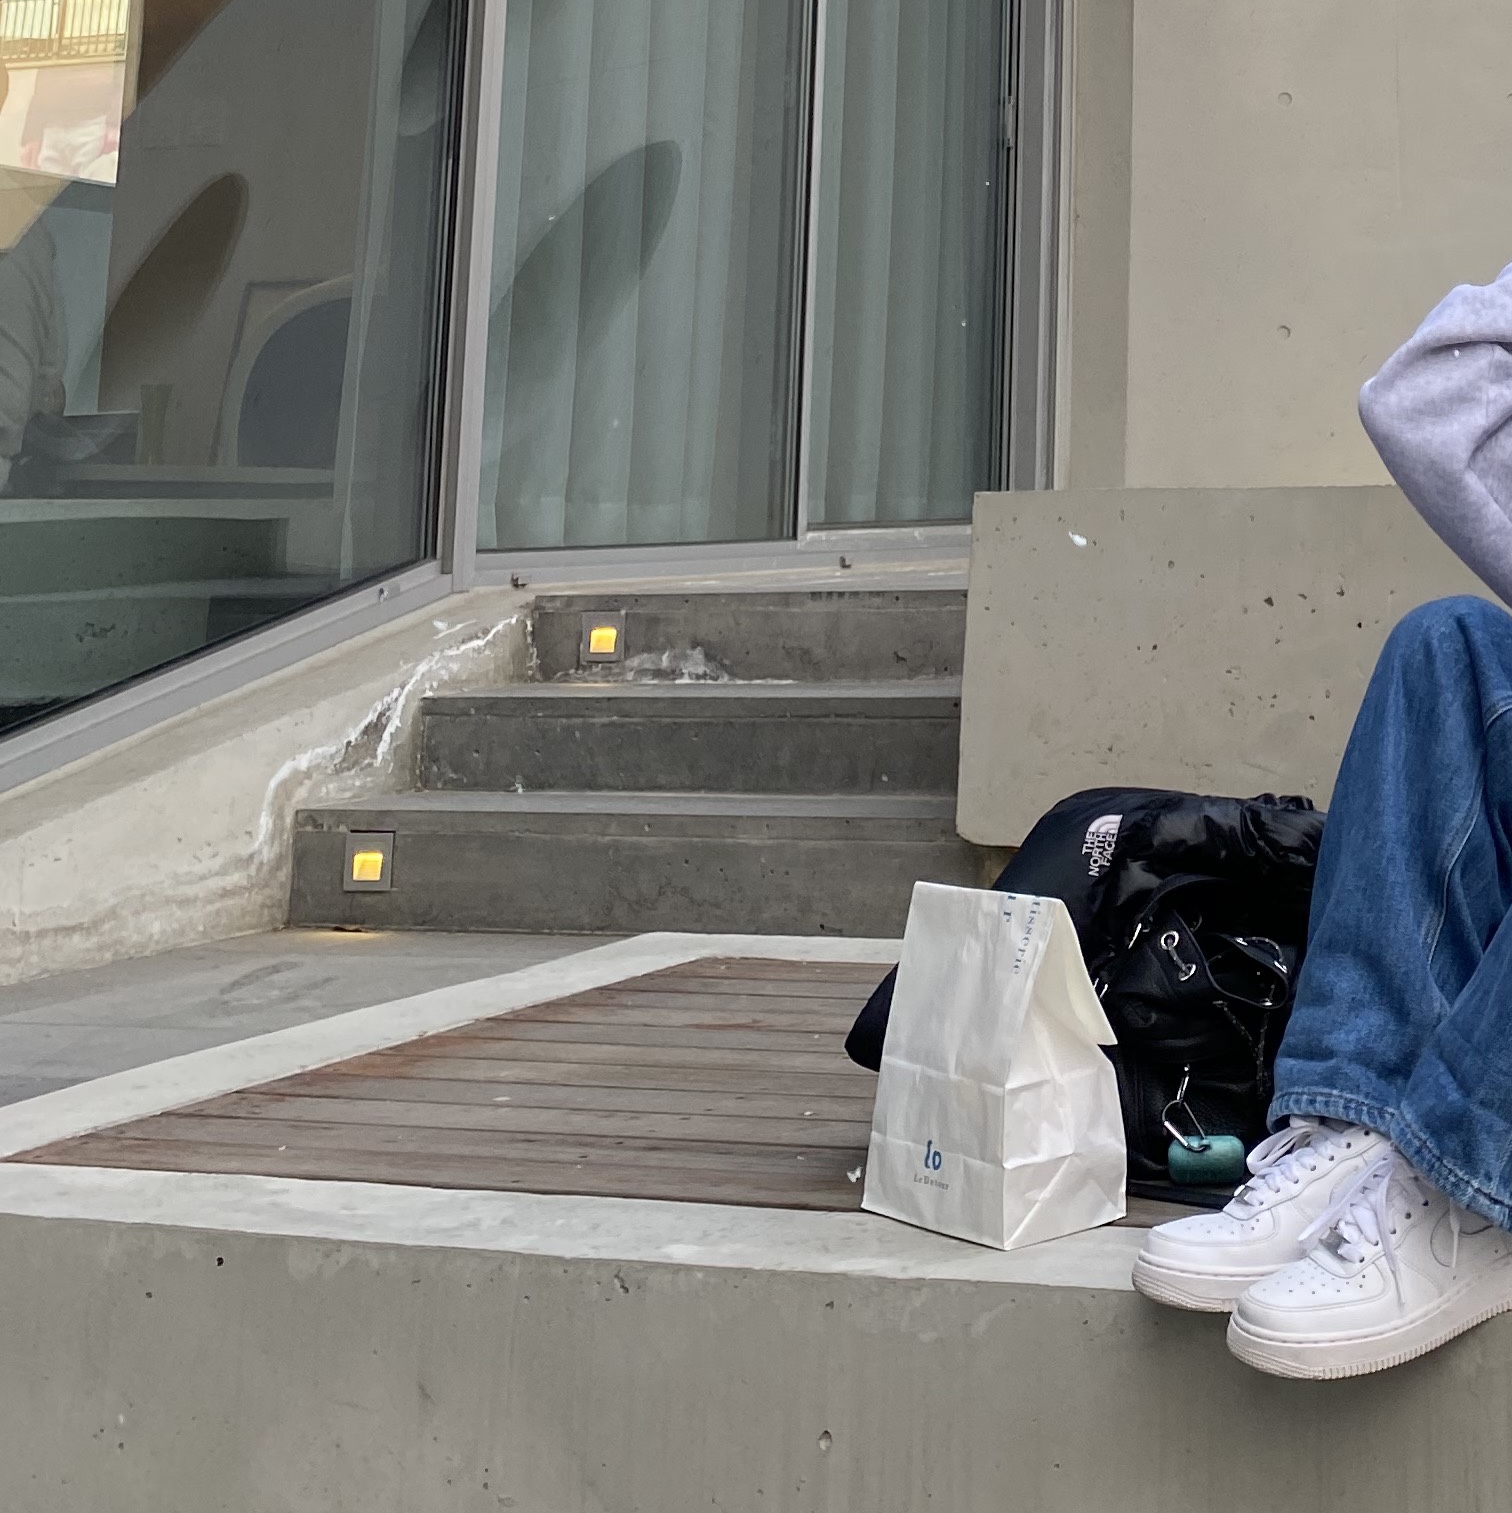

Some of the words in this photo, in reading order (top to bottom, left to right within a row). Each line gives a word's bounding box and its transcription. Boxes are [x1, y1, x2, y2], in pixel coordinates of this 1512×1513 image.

[1081, 831, 1097, 855] THE
[1088, 832, 1107, 877] NORTH
[1101, 833, 1118, 866] FACE
[1012, 895, 1041, 975] tisserie
